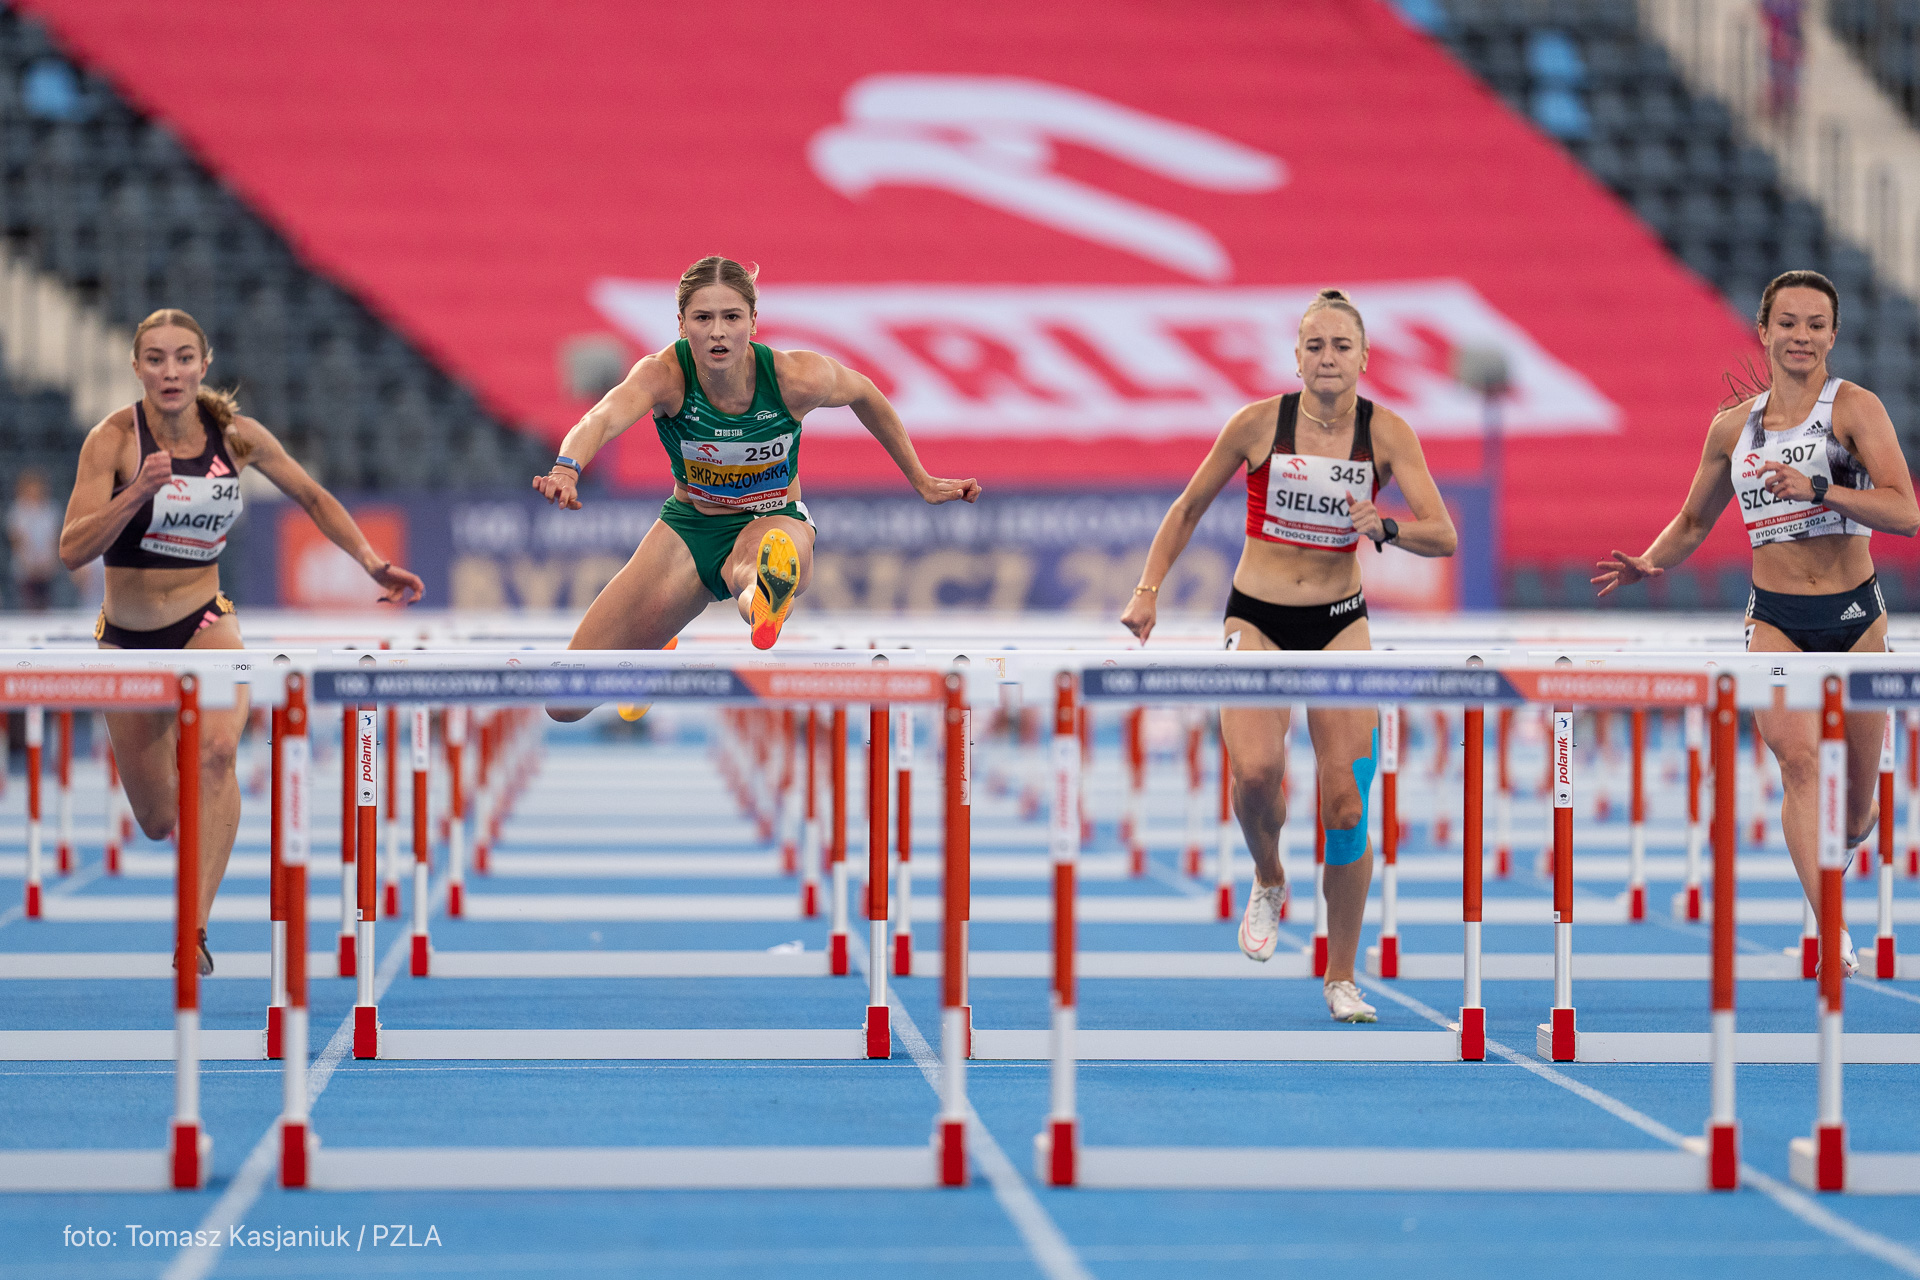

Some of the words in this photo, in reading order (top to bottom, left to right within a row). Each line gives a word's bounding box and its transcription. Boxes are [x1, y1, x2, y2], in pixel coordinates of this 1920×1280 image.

[757, 411, 778, 420] Enea
[695, 456, 723, 465] ORLEN
[744, 442, 784, 462] 250
[1781, 443, 1817, 465] 307
[690, 464, 789, 490] SKRZYSZOWSKA
[1282, 472, 1308, 481] ORLEN
[1330, 465, 1366, 485] 345
[166, 494, 191, 502] ORLEN
[212, 484, 240, 501] 341
[727, 493, 763, 506] Mistrzostwa
[763, 490, 782, 500] Polski
[760, 500, 784, 511] 2024
[1275, 489, 1351, 517] SIELSK
[1807, 507, 1824, 517] Polski
[1274, 527, 1329, 543] BYDGOSZCZ
[1755, 524, 1804, 540] BYDGOSZCZ
[1804, 516, 1827, 528] 2024
[1329, 597, 1359, 617] NIKE
[1840, 610, 1867, 621] adidas
[360, 733, 374, 783] polanik
[1556, 736, 1571, 785] polanik
